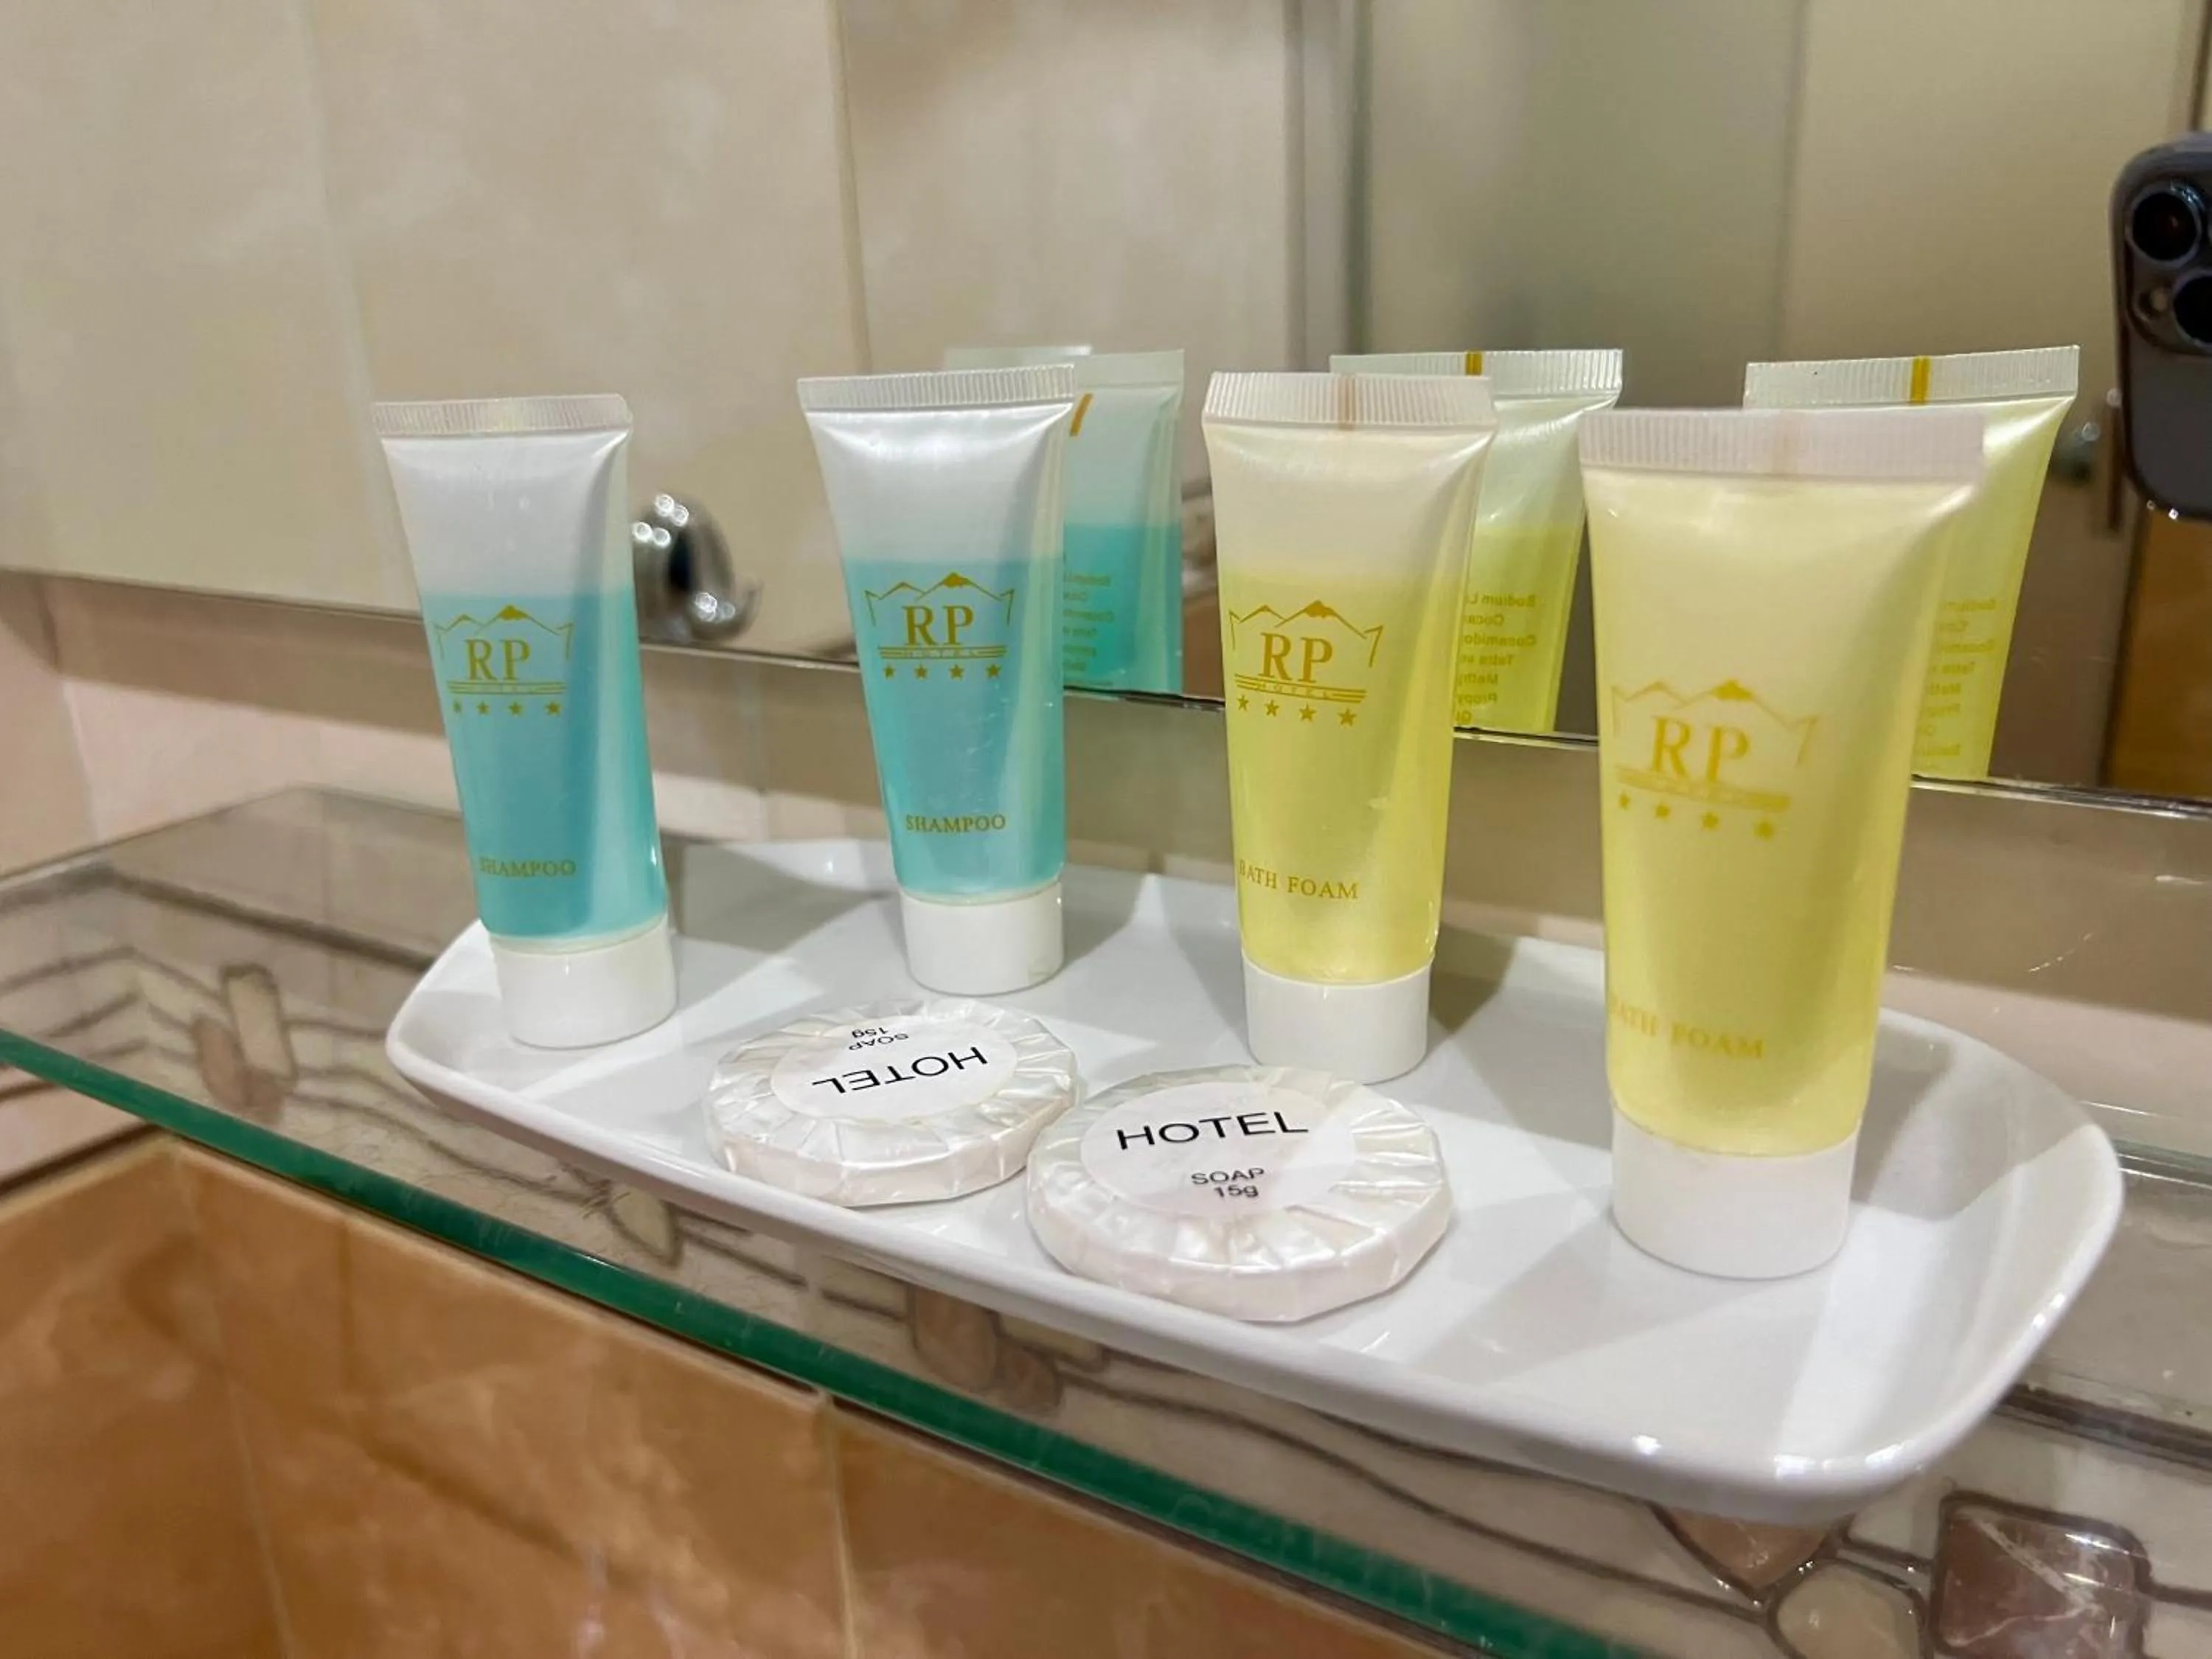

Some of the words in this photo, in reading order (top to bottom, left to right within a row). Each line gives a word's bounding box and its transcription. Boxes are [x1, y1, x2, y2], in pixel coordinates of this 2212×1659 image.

[902, 605, 975, 647] RP
[465, 639, 530, 681] RP
[1258, 632, 1334, 684] RP
[1648, 714, 1750, 784] RP
[906, 814, 1006, 833] SHAMPOO
[479, 856, 577, 877] SHAMPOO
[1239, 859, 1278, 889] BATH
[1287, 875, 1360, 900] FOAM
[849, 1033, 909, 1051] SOAP
[851, 1027, 889, 1039] 15g
[1670, 1020, 1765, 1060] FOAM
[812, 1046, 988, 1094] HOTEL
[1116, 1111, 1310, 1150] HOTEL
[1191, 1167, 1265, 1185] SOAP
[1214, 1184, 1259, 1198] 15g
